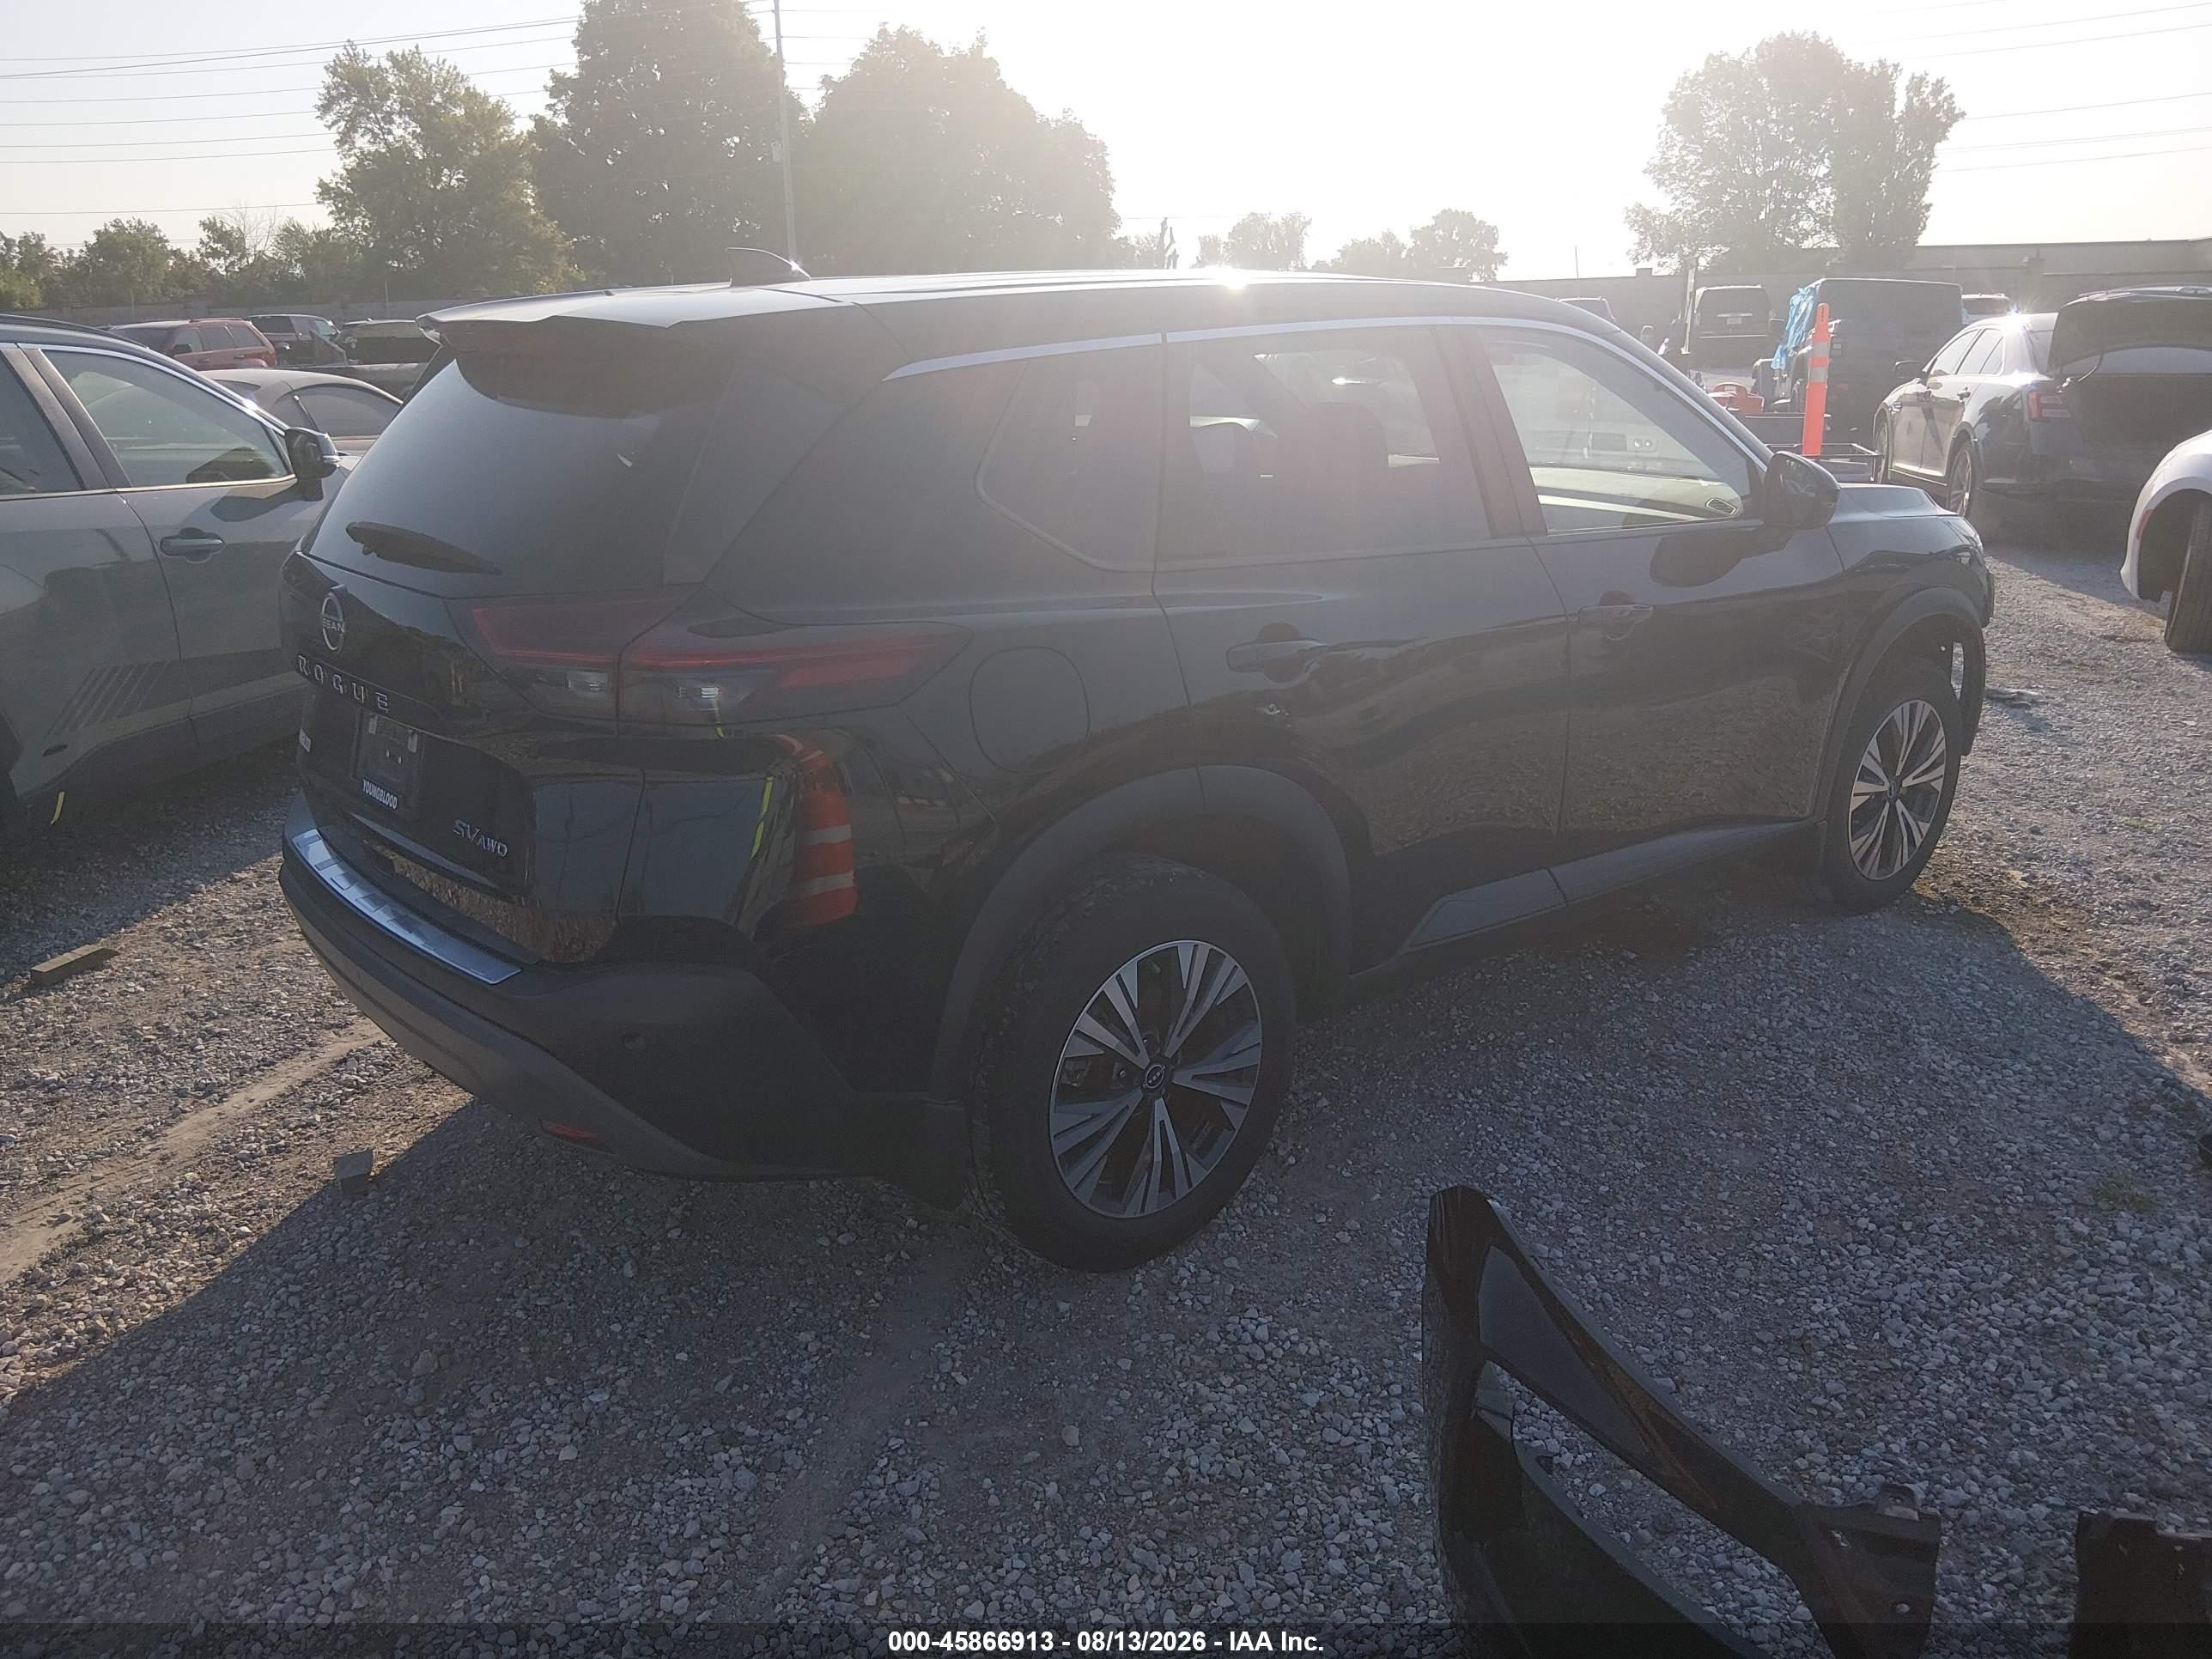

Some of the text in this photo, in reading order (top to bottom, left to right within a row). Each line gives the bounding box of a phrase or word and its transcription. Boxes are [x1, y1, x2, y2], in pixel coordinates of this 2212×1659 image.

[298, 654, 389, 714] ROGUE
[362, 777, 398, 810] YOUNGBLOOD
[453, 818, 508, 857] SV AWD
